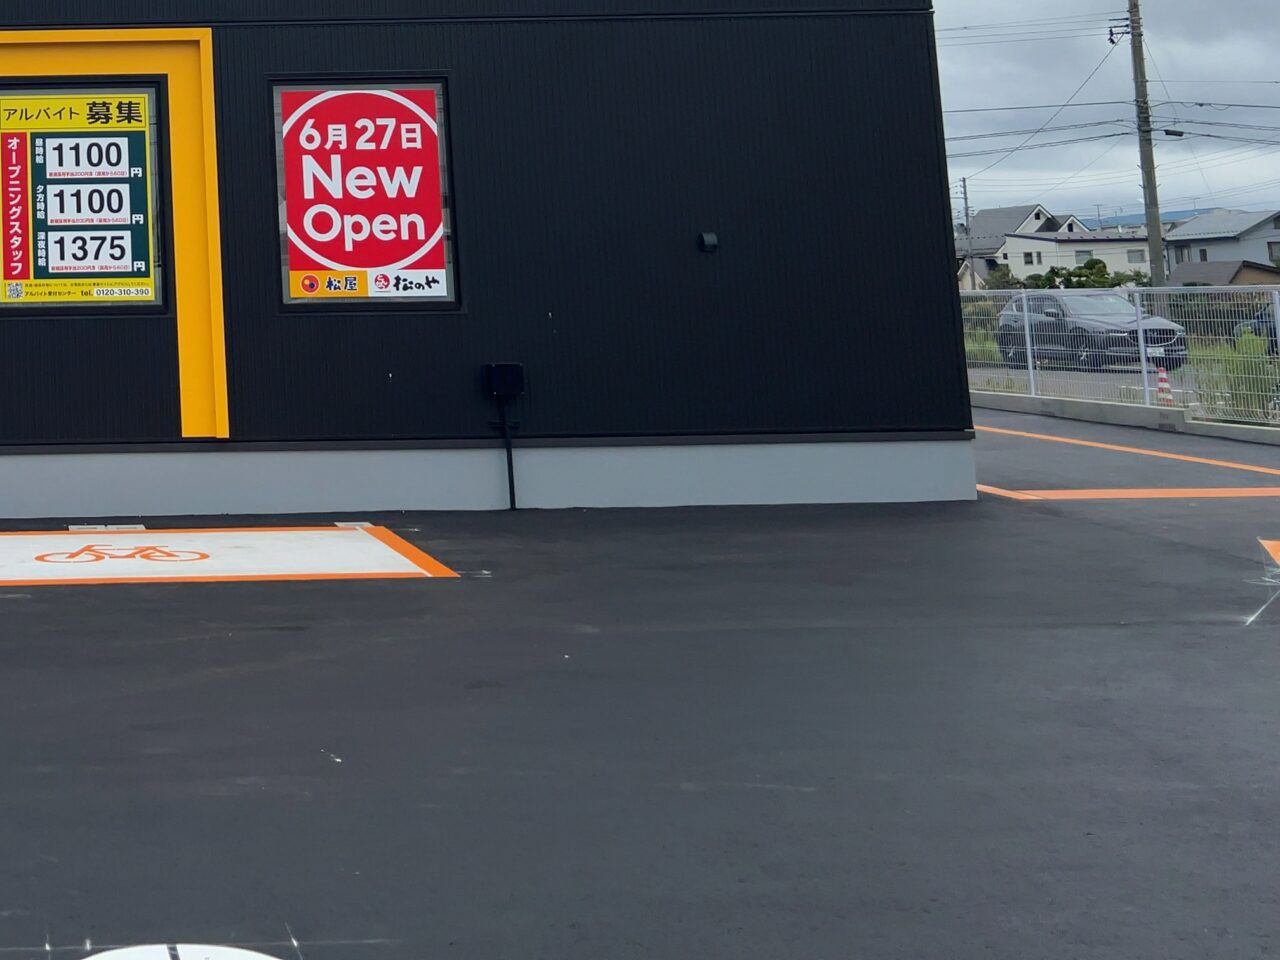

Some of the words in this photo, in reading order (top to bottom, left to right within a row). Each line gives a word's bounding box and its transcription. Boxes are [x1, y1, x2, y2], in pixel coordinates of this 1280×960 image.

[3, 107, 79, 121] アルバイト
[86, 100, 143, 125] 募集
[299, 118, 422, 150] 6月27日
[52, 142, 122, 167] 1100
[130, 167, 142, 177] 円
[302, 154, 423, 200] New
[7, 137, 22, 276] オープニングスタッフ
[53, 188, 123, 214] 1100
[132, 214, 144, 224] 円
[303, 203, 426, 252] Open
[54, 236, 126, 261] 1375
[133, 261, 145, 271] 円
[96, 288, 150, 296] 0120-310-390
[326, 276, 358, 291] 松屋
[393, 275, 440, 291] 松のや
